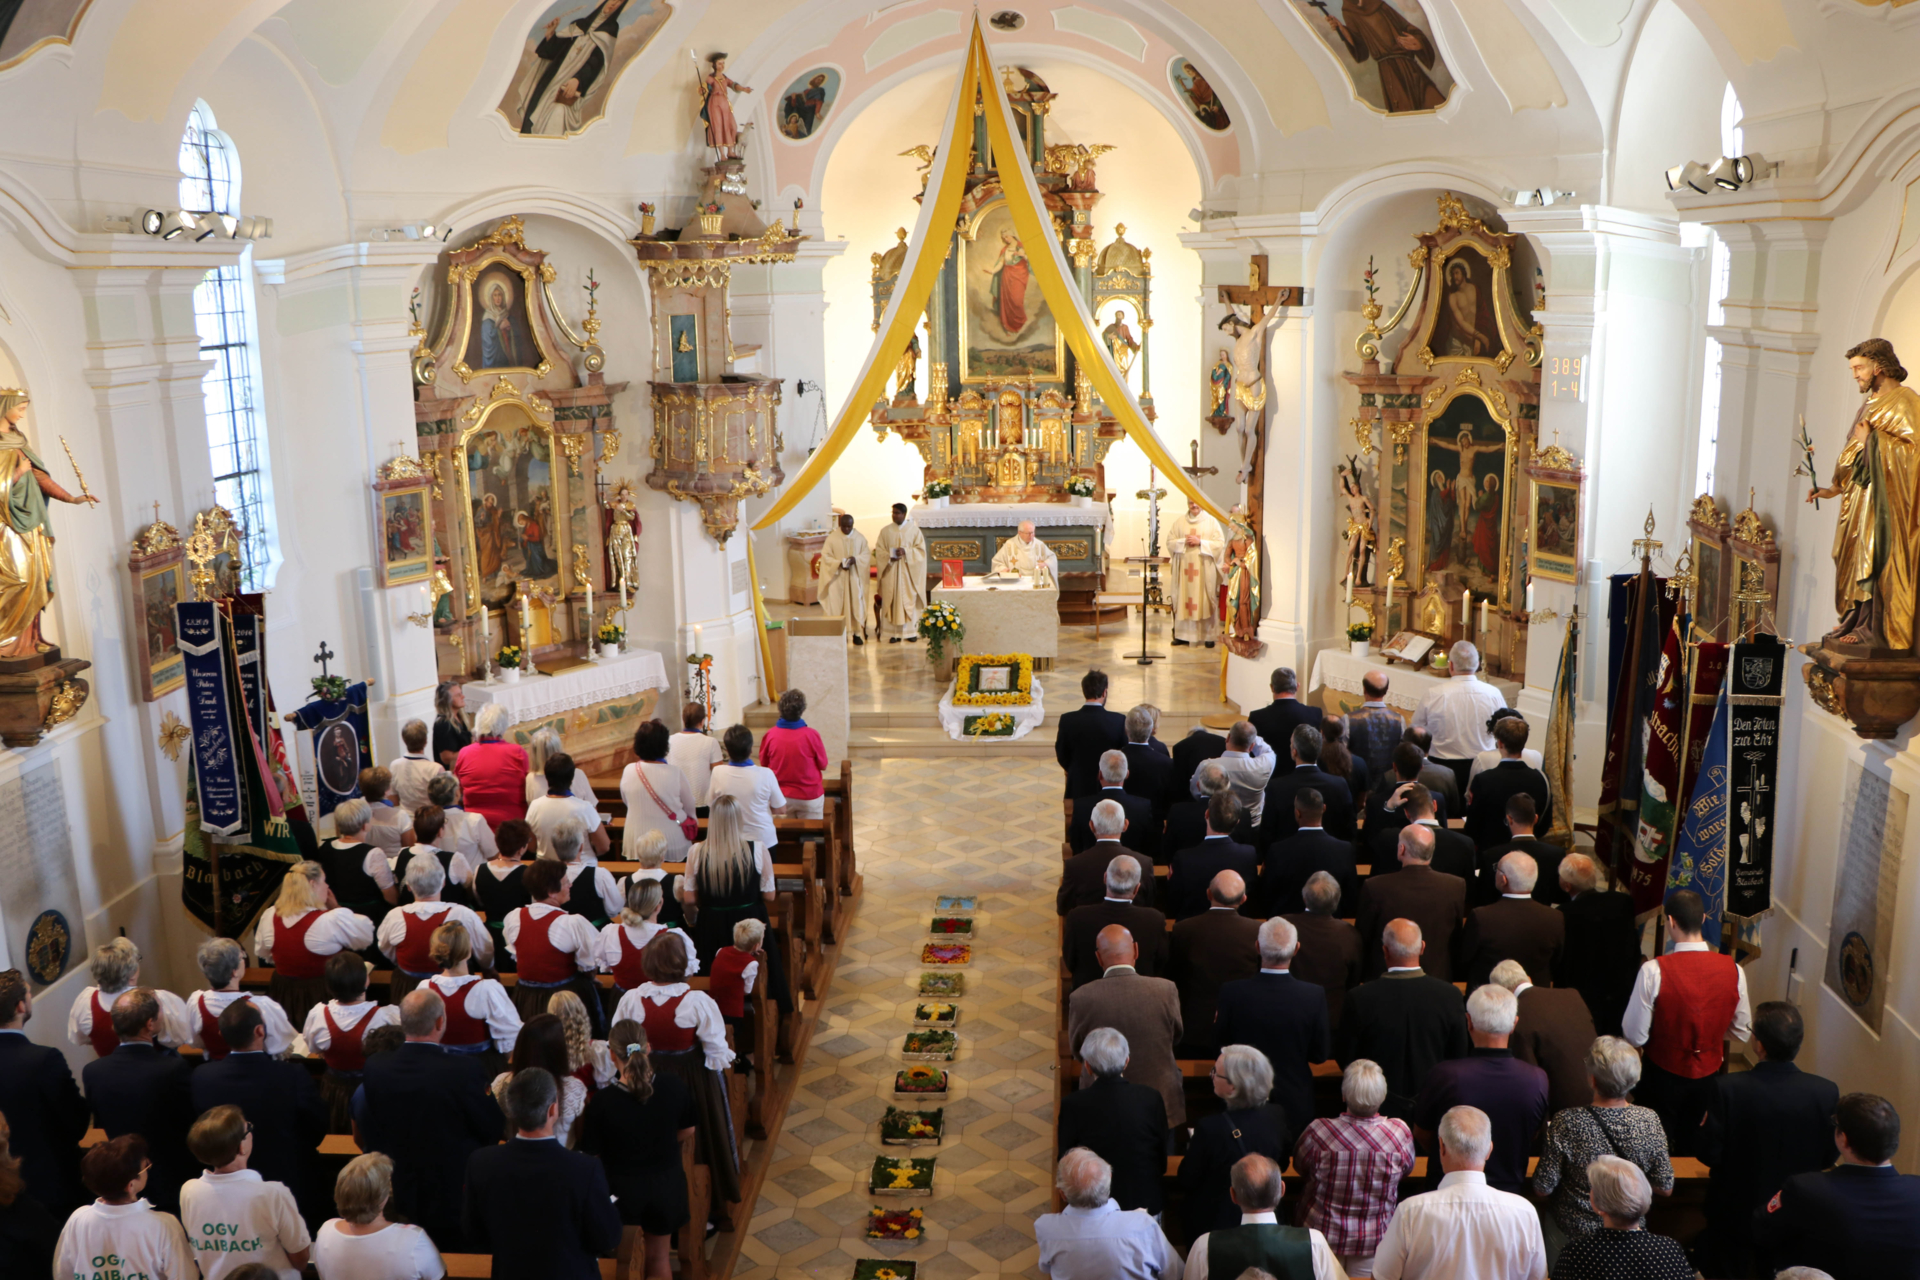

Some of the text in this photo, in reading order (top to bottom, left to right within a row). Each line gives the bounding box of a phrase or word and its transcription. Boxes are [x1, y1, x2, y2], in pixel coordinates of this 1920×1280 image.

[1551, 357, 1581, 376] 389
[1551, 380, 1579, 399] 1-4
[190, 668, 218, 678] Unserem
[197, 696, 217, 705] Dank
[1733, 717, 1777, 731] Den Toten
[1733, 736, 1752, 747] zur
[1693, 795, 1720, 818] Wir
[263, 819, 291, 838] WIR
[1698, 818, 1727, 841] ware
[186, 860, 264, 884] Blabach
[1734, 877, 1765, 887] Blaibach
[202, 1222, 239, 1237] OGV
